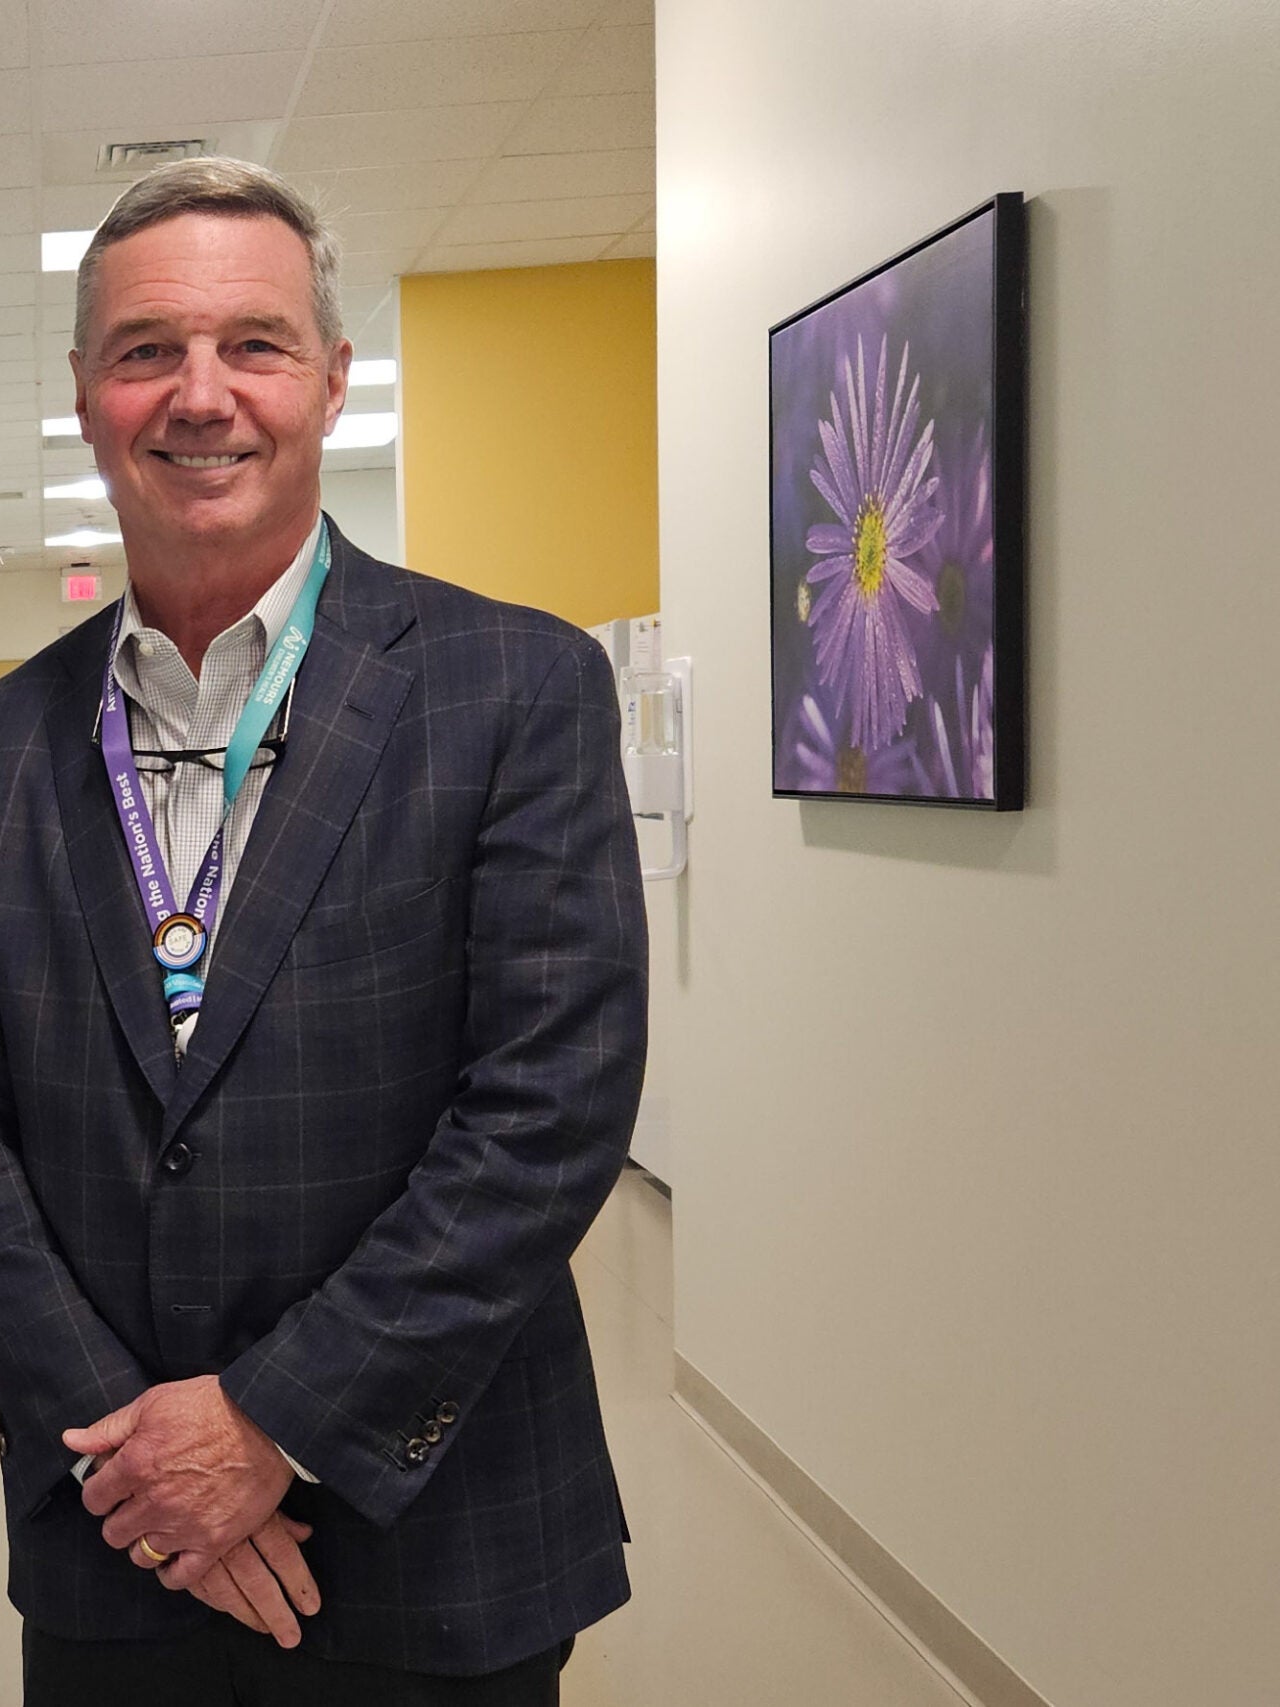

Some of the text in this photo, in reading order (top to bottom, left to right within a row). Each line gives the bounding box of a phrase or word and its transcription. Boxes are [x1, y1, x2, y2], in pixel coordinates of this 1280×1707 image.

[263, 652, 296, 705] NEMOURS
[116, 772, 135, 809] Best
[128, 811, 155, 877] Nation's
[148, 880, 164, 908] the
